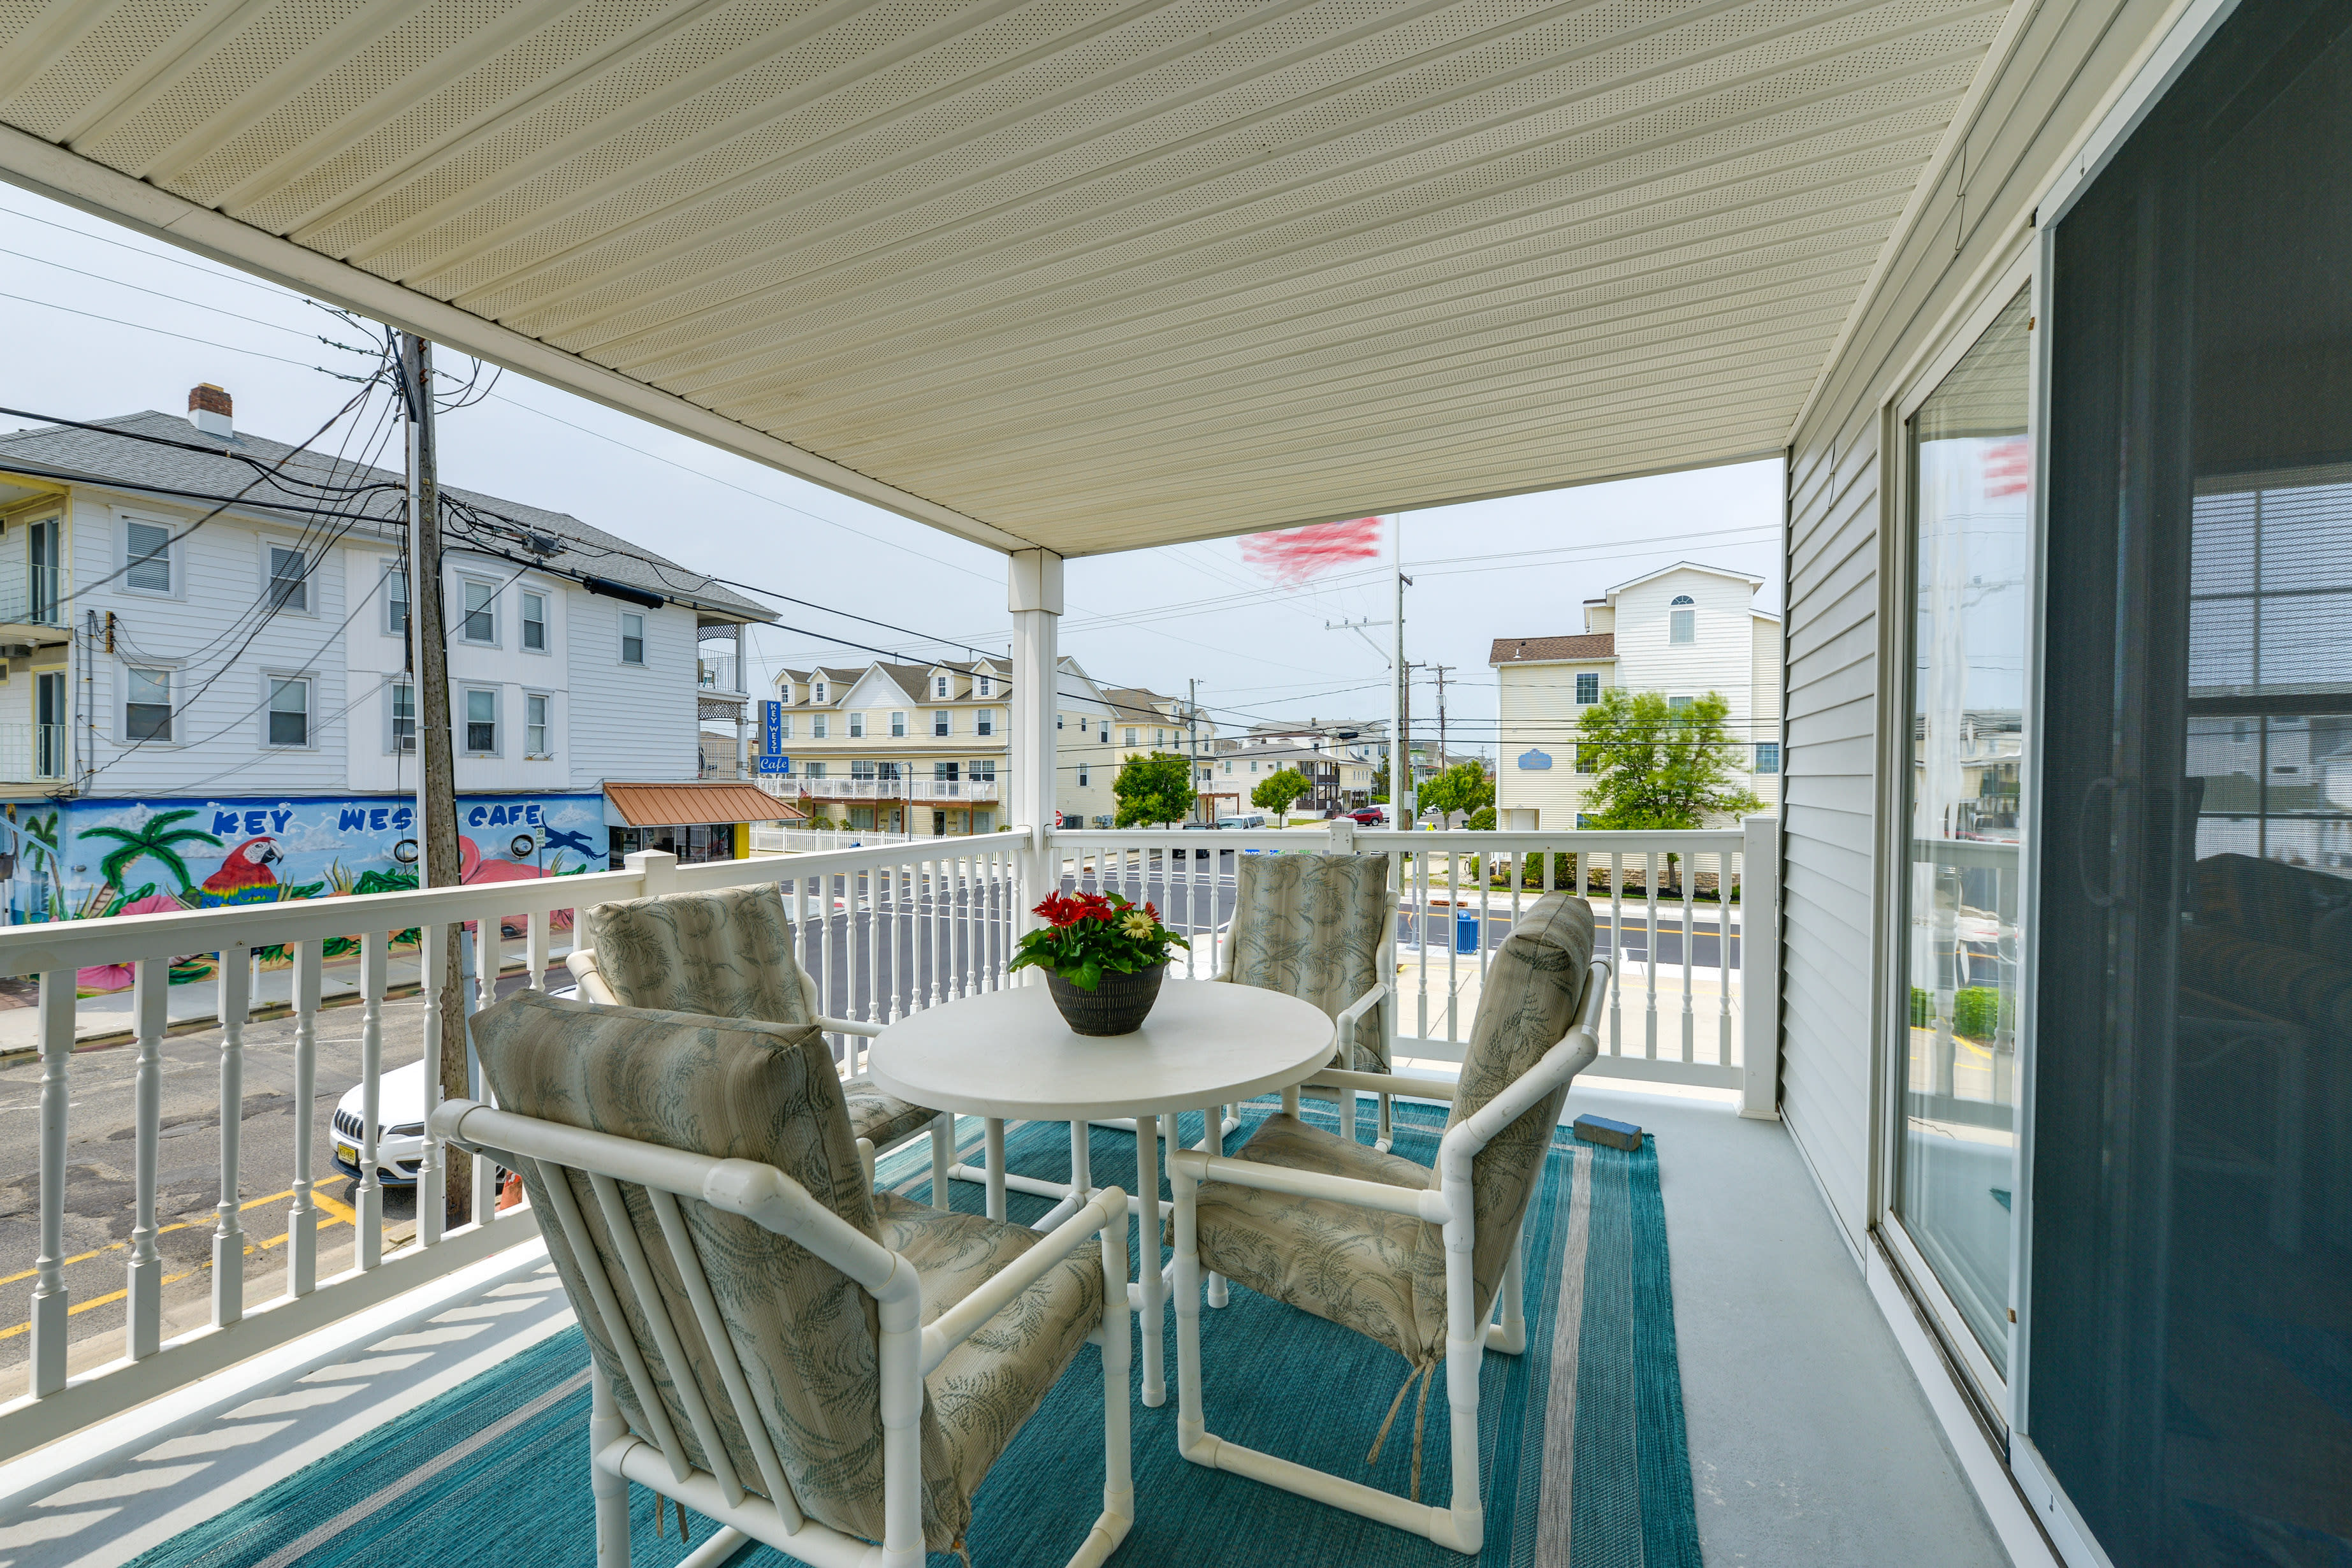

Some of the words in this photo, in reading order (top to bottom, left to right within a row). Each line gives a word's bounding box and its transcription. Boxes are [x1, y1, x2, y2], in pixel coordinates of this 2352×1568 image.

[769, 725, 779, 753] WEST
[760, 757, 788, 772] Cafe
[211, 809, 294, 836] KEY
[338, 807, 418, 832] WES
[468, 804, 541, 827] CAFE
